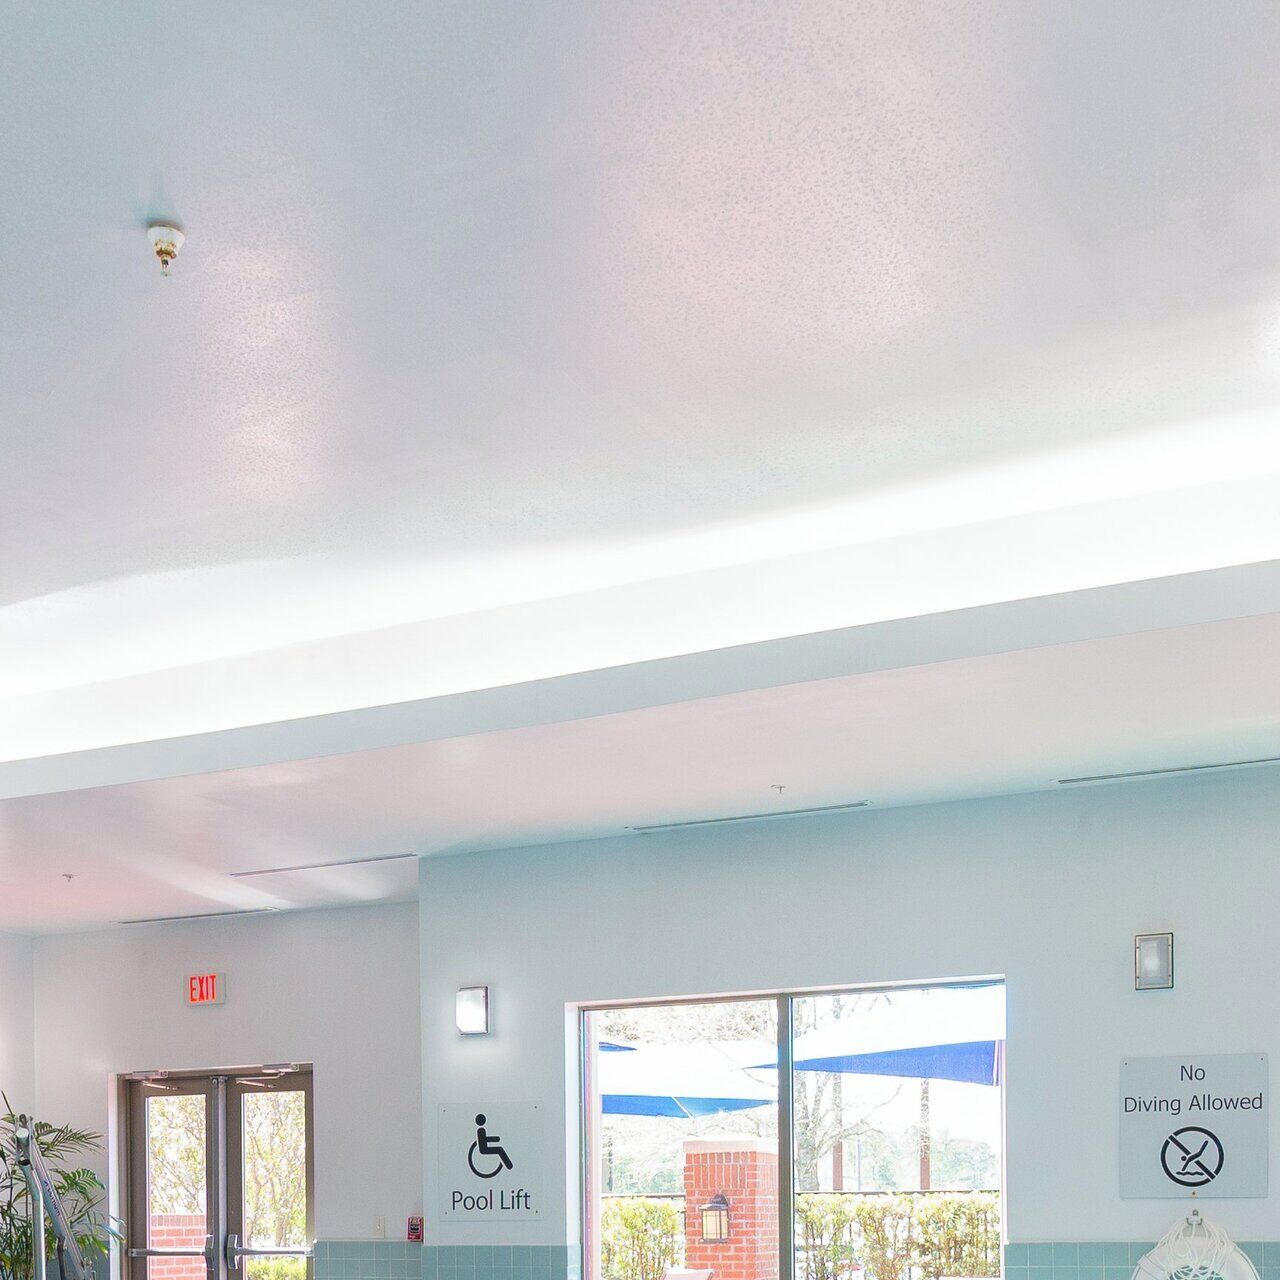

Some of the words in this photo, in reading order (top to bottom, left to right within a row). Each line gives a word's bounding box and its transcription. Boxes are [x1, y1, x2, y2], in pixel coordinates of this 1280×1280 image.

[190, 975, 216, 1002] EXIT
[1180, 1065, 1206, 1081] No
[1124, 1096, 1181, 1116] Diving
[1188, 1092, 1263, 1111] Allowed
[452, 1189, 493, 1210] Pool
[500, 1188, 531, 1210] Lift
